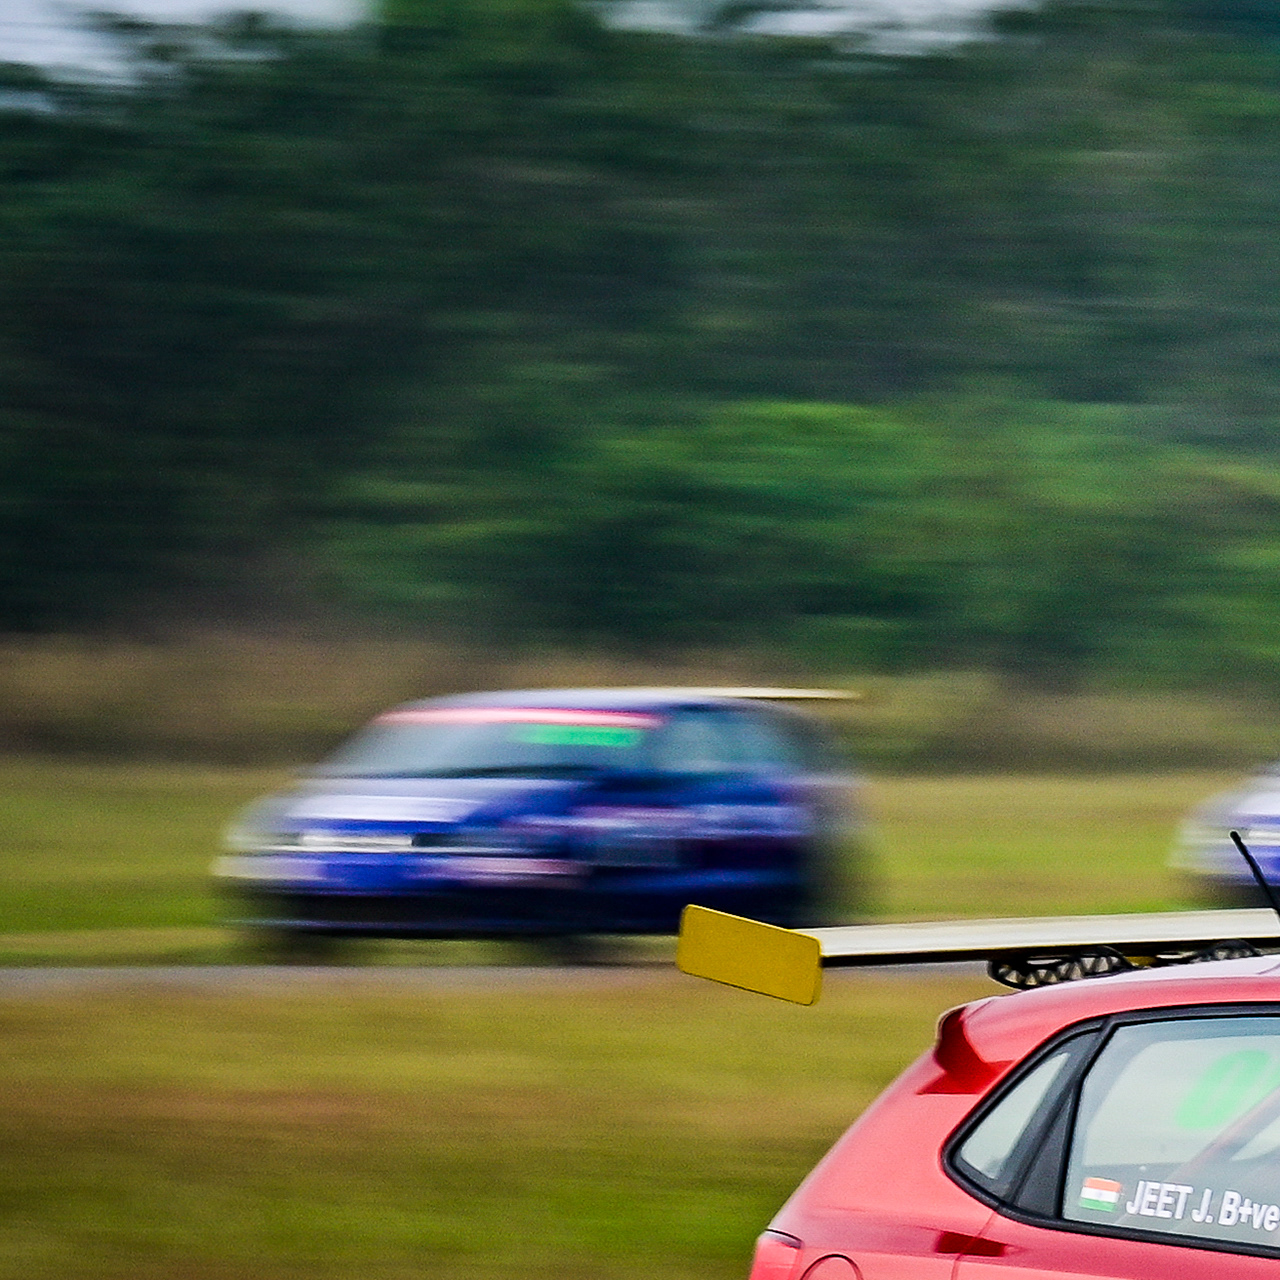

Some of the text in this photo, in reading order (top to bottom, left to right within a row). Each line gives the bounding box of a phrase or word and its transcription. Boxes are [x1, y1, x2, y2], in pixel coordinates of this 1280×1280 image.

[1126, 1180, 1280, 1232] JEET J. B+ve
